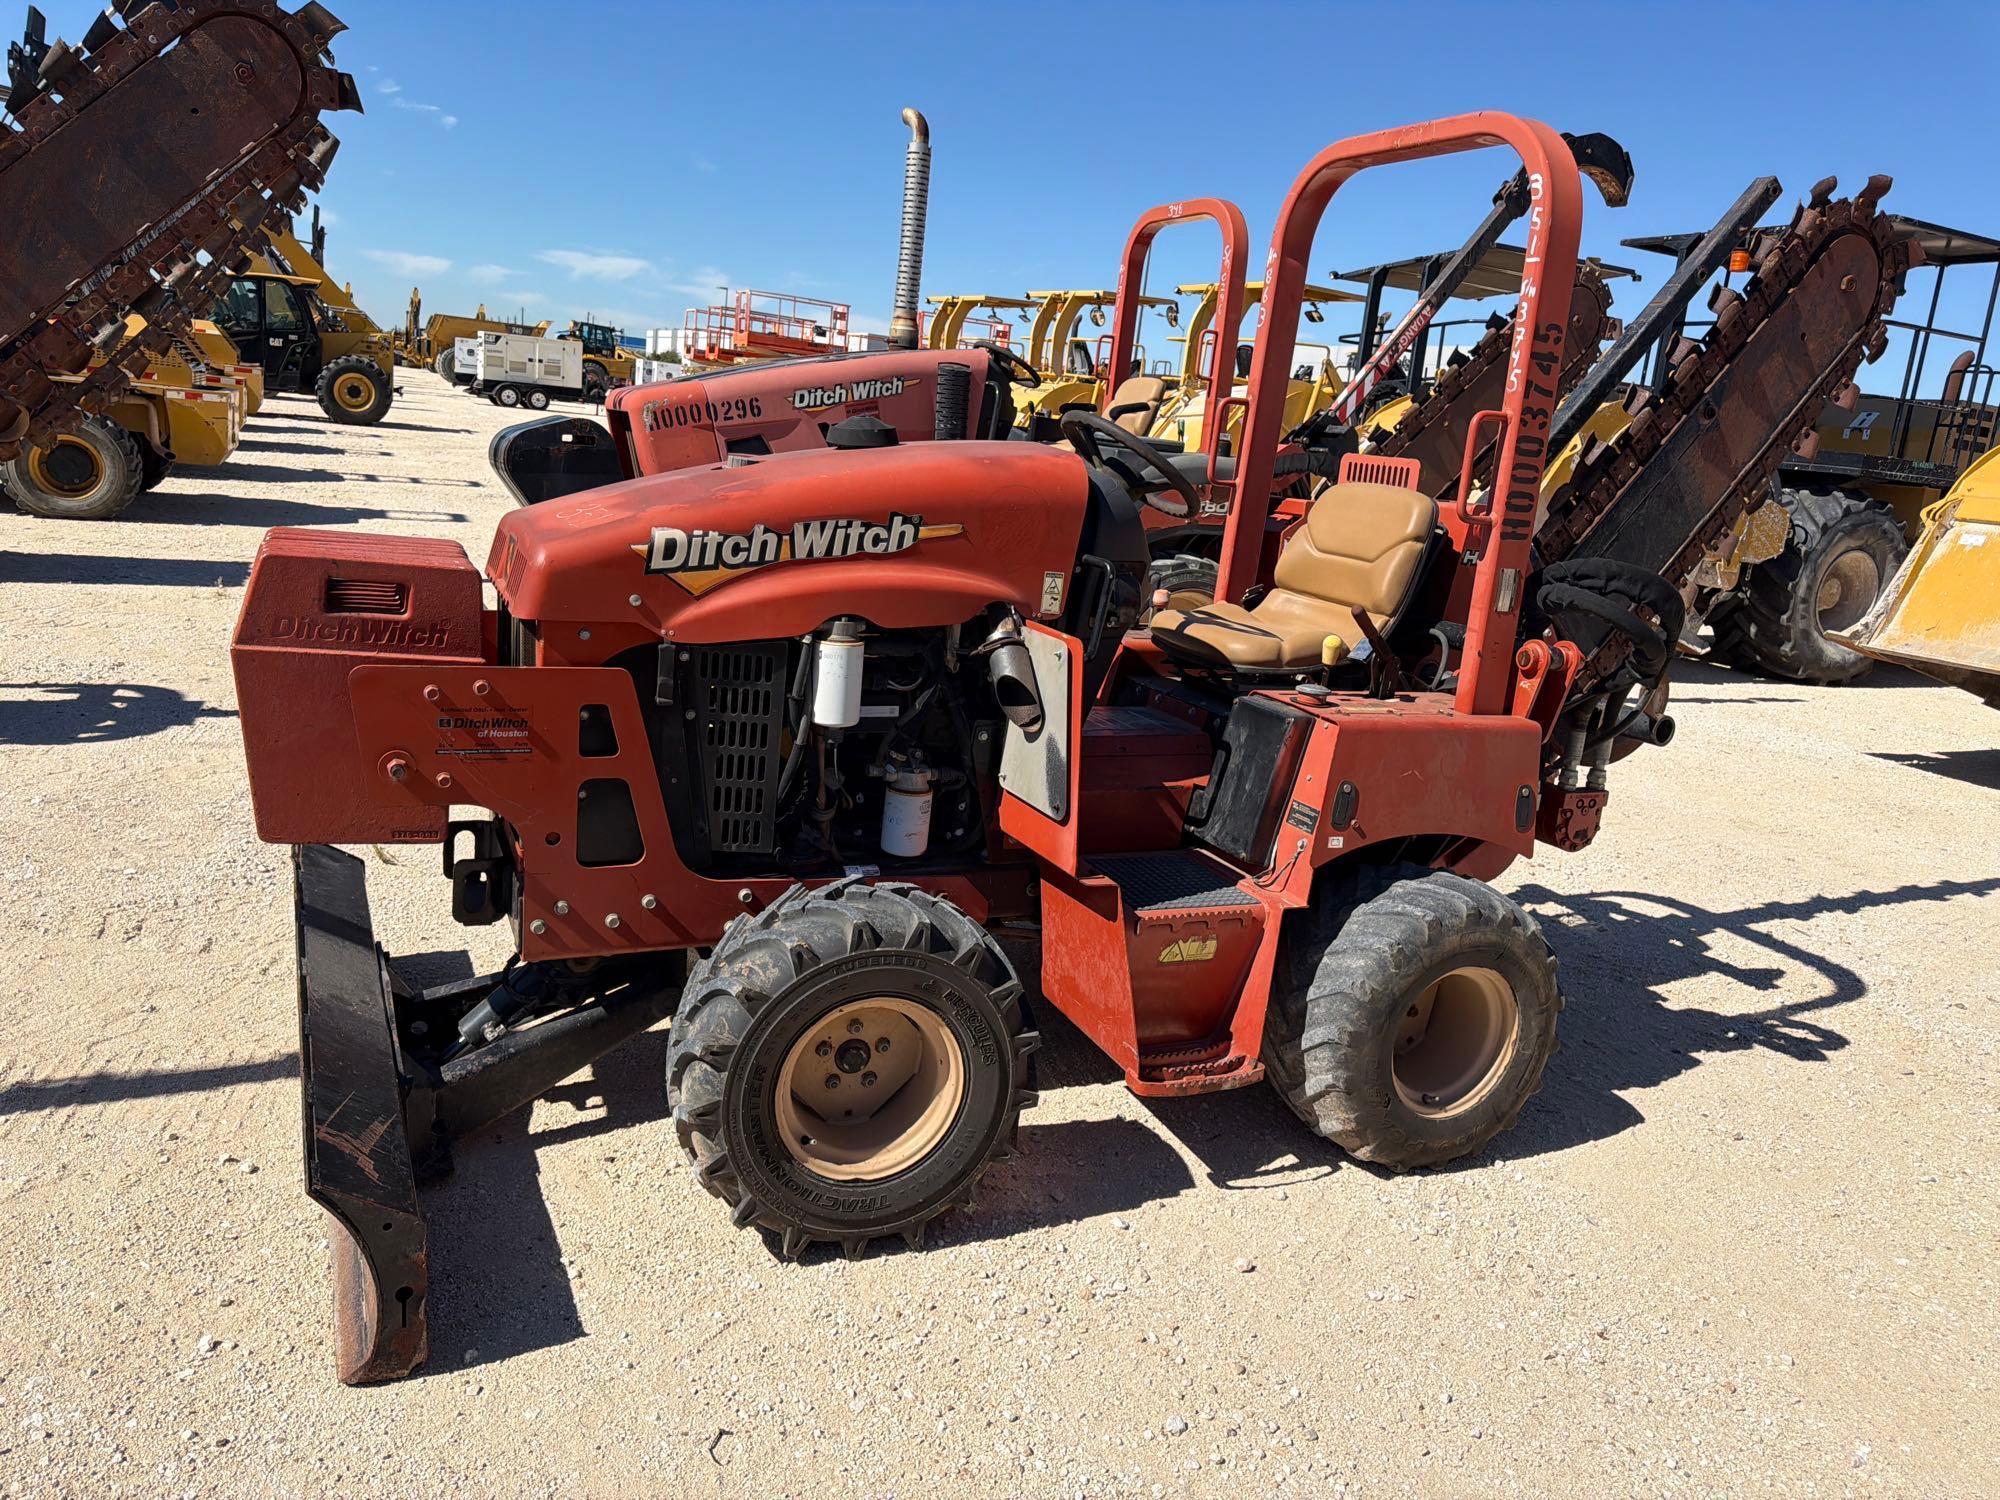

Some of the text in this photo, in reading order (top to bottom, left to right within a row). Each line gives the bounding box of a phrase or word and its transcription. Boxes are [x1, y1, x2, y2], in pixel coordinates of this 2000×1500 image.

[269, 338, 283, 346] CAT
[1505, 302, 1528, 392] 3745
[794, 377, 903, 408] Ditch Witch
[650, 515, 916, 570] Ditch Witch
[271, 616, 451, 648] Ditch Witch
[454, 718, 528, 729] Ditch Witch
[942, 987, 997, 1067] HERCULES
